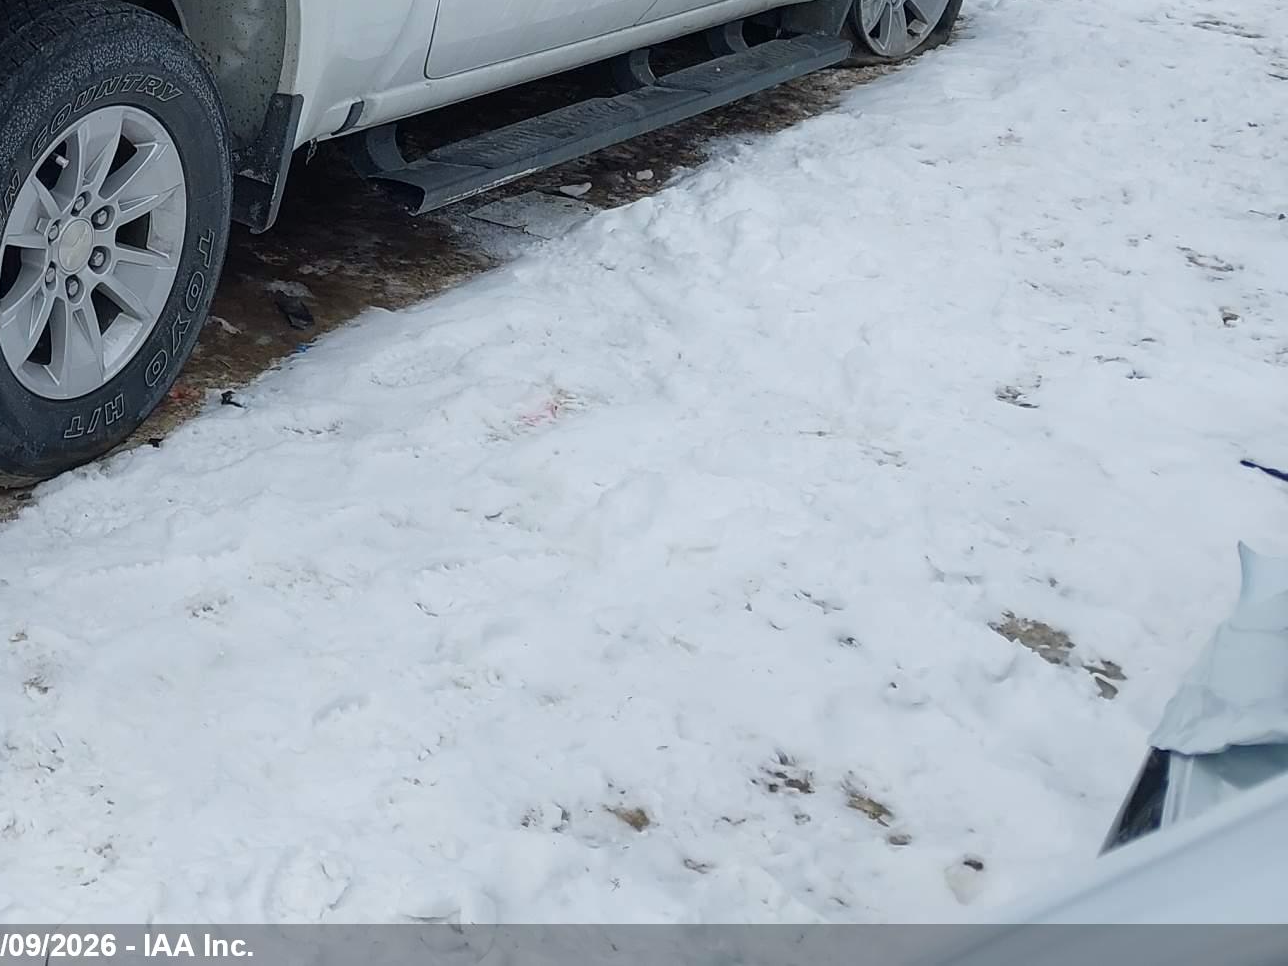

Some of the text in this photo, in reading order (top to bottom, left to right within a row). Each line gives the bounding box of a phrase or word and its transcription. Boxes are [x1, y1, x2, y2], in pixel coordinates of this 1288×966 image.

[31, 74, 184, 160] COUNTRY
[63, 229, 215, 439] TOYO H/T
